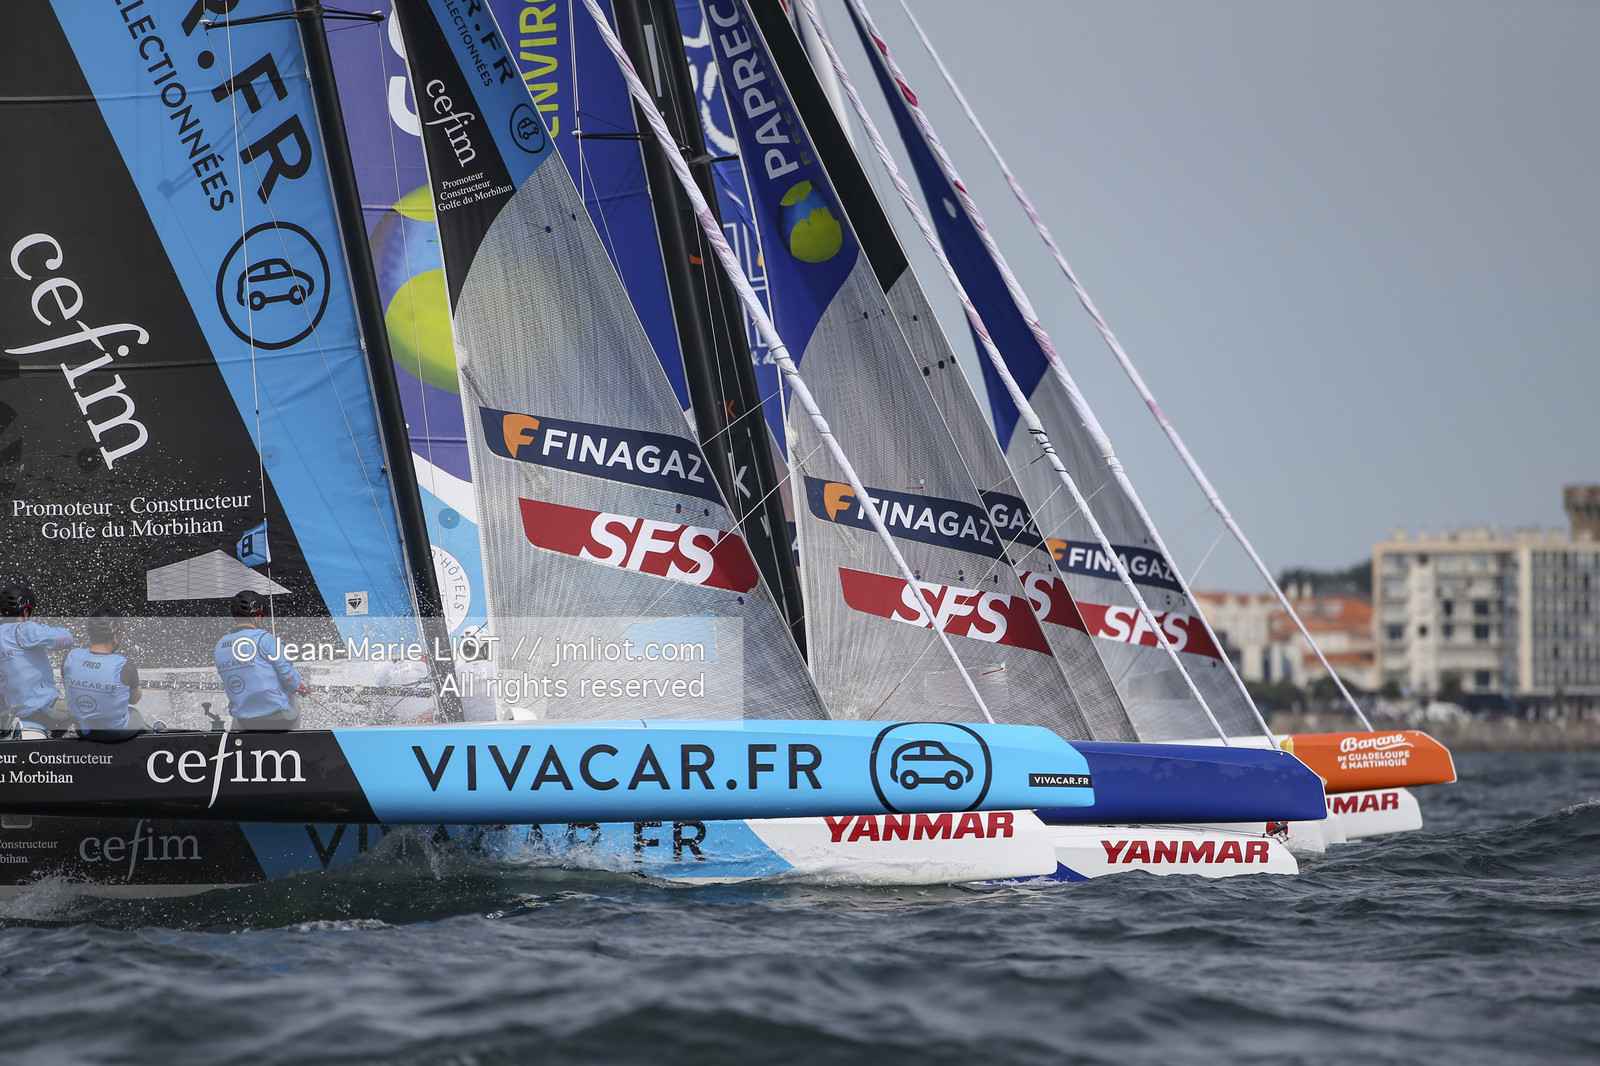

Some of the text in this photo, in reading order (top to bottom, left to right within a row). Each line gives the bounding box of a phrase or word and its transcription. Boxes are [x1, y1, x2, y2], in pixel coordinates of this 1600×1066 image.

[444, 0, 493, 87] LECTIONNÉES
[519, 0, 559, 138] NVIR
[115, 0, 234, 211] LECTIONNÉES
[425, 79, 477, 168] cefim
[440, 180, 491, 200] Constructeur
[442, 172, 484, 189] Promoteur
[438, 184, 513, 212] Golfe du Morbihan
[4, 233, 150, 470] cefim
[541, 428, 705, 484] FINAGAZ
[12, 500, 113, 517] Promoteur
[130, 495, 251, 513] Constructeur
[41, 518, 224, 540] Golfe du Morbihan
[578, 512, 720, 585] SFS
[890, 581, 1012, 643] SFS
[1098, 605, 1190, 652] SFS
[82, 660, 102, 670] FRED
[1340, 733, 1414, 753] Banane
[1348, 750, 1411, 761] GUADELOUPE
[28, 751, 113, 765] Constructeur
[146, 732, 307, 809] cefim
[411, 744, 823, 791] VIVACAR.FR
[1349, 758, 1408, 769] MARTINIQUE
[9, 770, 74, 784] Morbihan
[1032, 776, 1089, 786] VIVACAR.FR
[825, 811, 1015, 843] YANMAR
[0, 840, 59, 850] onstructeur
[79, 819, 202, 881] cefim
[1100, 839, 1271, 865] YANMAR
